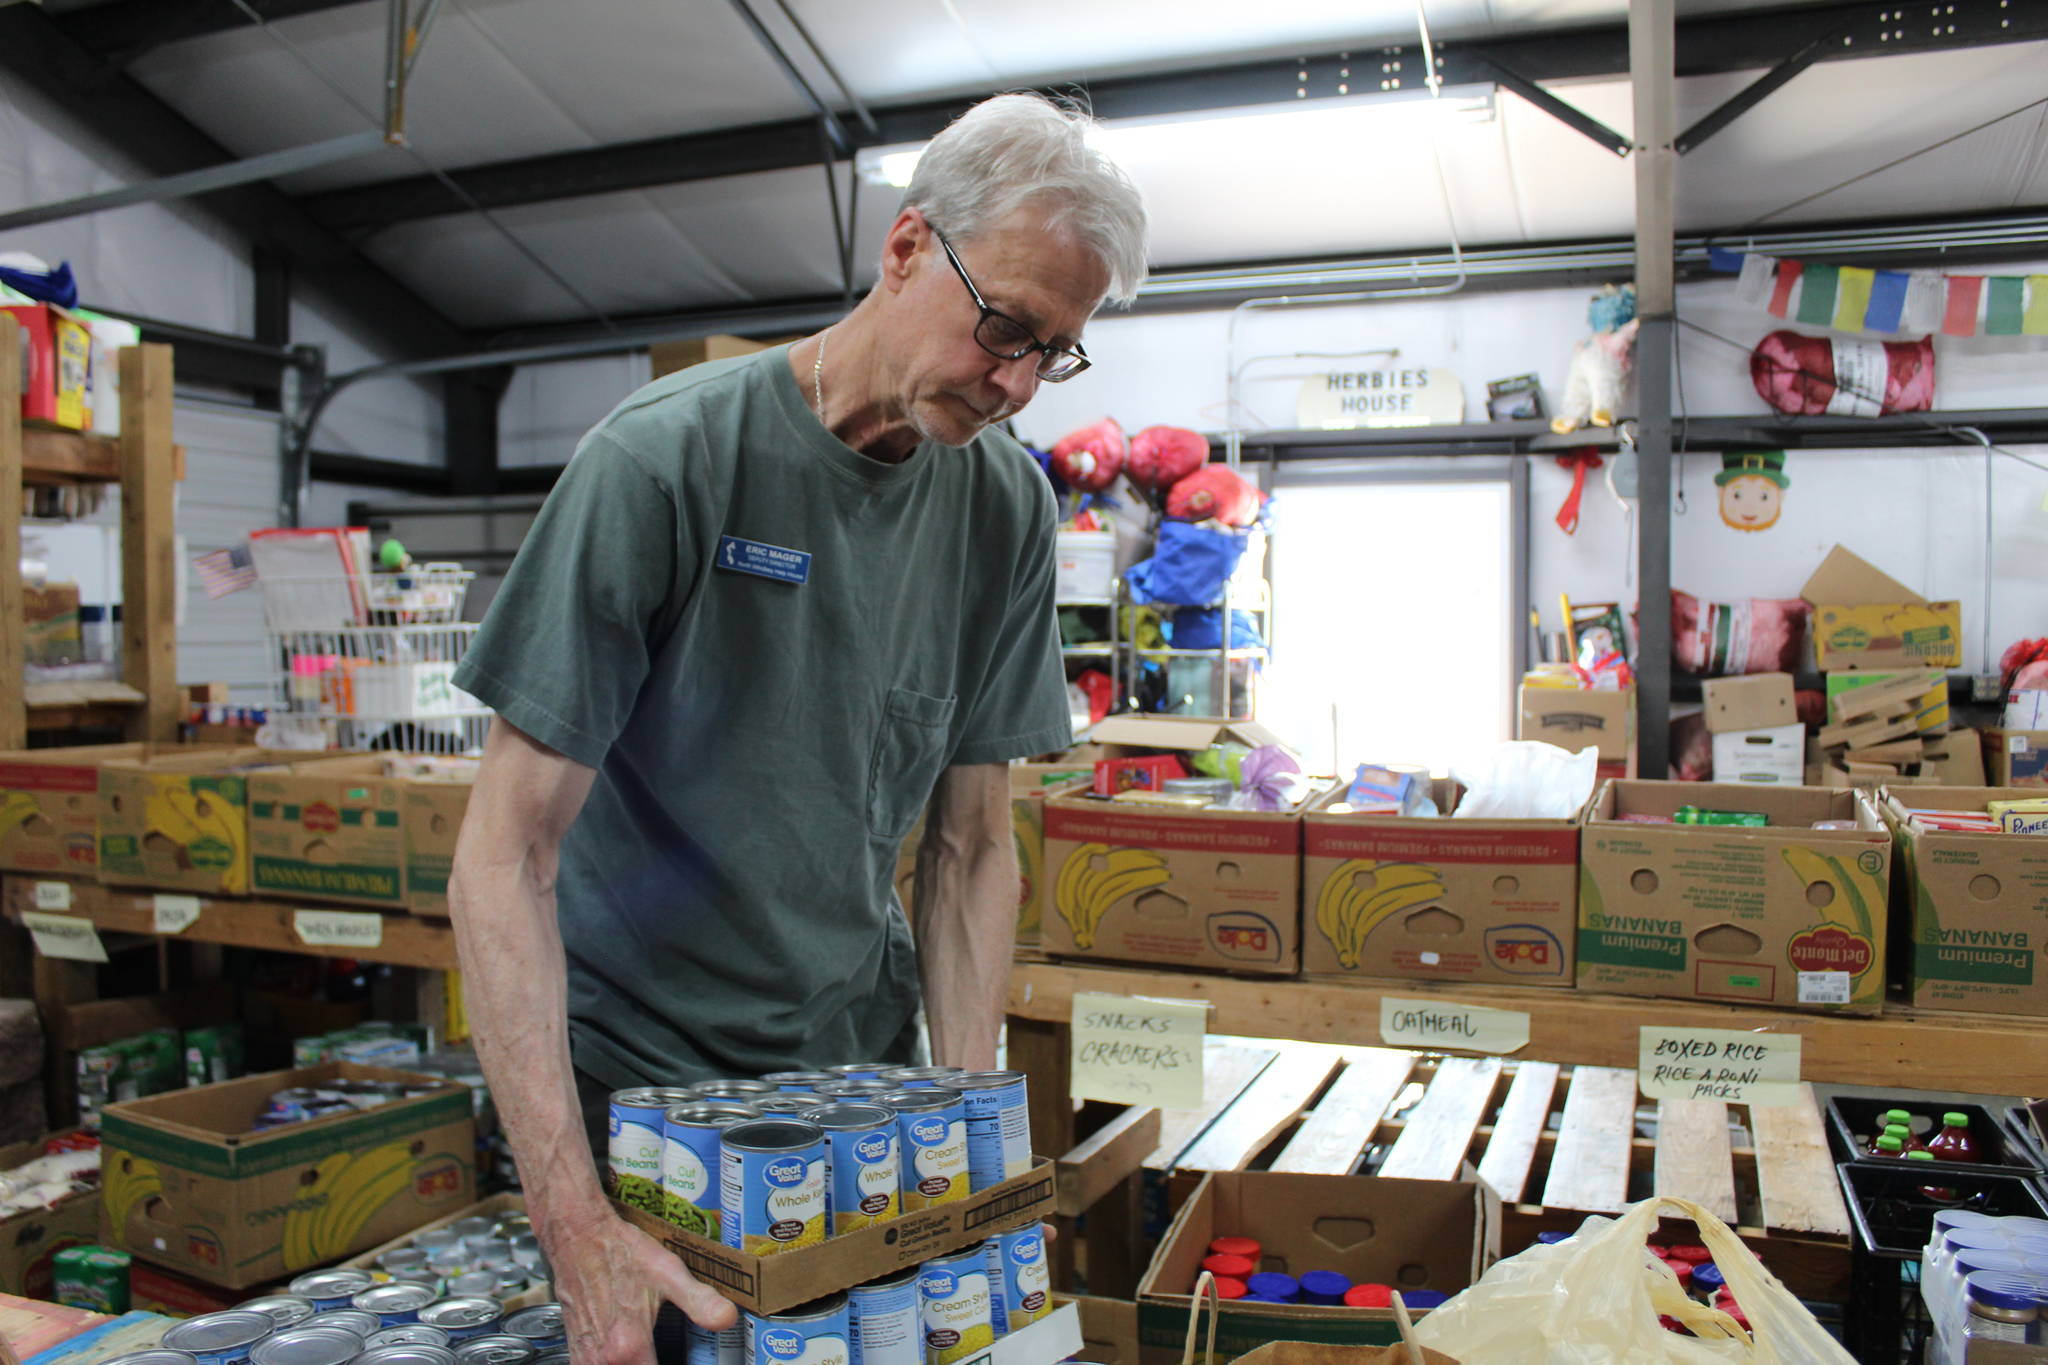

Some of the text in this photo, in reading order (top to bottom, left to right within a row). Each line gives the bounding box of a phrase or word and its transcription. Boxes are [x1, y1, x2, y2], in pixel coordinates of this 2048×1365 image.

[1326, 369, 1428, 391] HERBIES
[1341, 393, 1413, 412] HOUSE
[745, 545, 802, 563] ERIC MAGER
[1438, 842, 1493, 856] BANANAS
[324, 870, 393, 896] PREMIUM
[1589, 913, 1682, 935] BANANAS
[1217, 930, 1267, 950] Dole
[1602, 935, 1681, 955] Premium
[1924, 928, 2028, 948] BANANAS
[1495, 943, 1549, 964] Dole
[1792, 946, 1865, 964] Del Monte
[1938, 950, 2027, 968] Premium
[1084, 1012, 1173, 1034] SNACKS
[1654, 1038, 1768, 1062] BOXED RICE
[1652, 1064, 1695, 1087] RICE
[1700, 1069, 1712, 1081] A
[976, 1096, 998, 1105] Facts
[913, 1123, 945, 1136] Great
[922, 1132, 945, 1142] Value
[639, 1146, 660, 1158] Cut
[858, 1139, 886, 1153] Great
[925, 1145, 957, 1161] Cream
[625, 1156, 659, 1169] Beans
[769, 1163, 802, 1176] Great
[678, 1165, 696, 1178] Cut
[777, 1174, 802, 1183] Value
[865, 1168, 893, 1183] Whole
[775, 1193, 811, 1208] Whole
[1014, 1241, 1039, 1255] Great
[921, 1277, 952, 1288] Great
[928, 1286, 952, 1294] Value
[932, 1299, 971, 1313] Cream
[945, 1311, 973, 1323] Sweet
[766, 1334, 798, 1347] Great
[773, 1346, 798, 1355] Value
